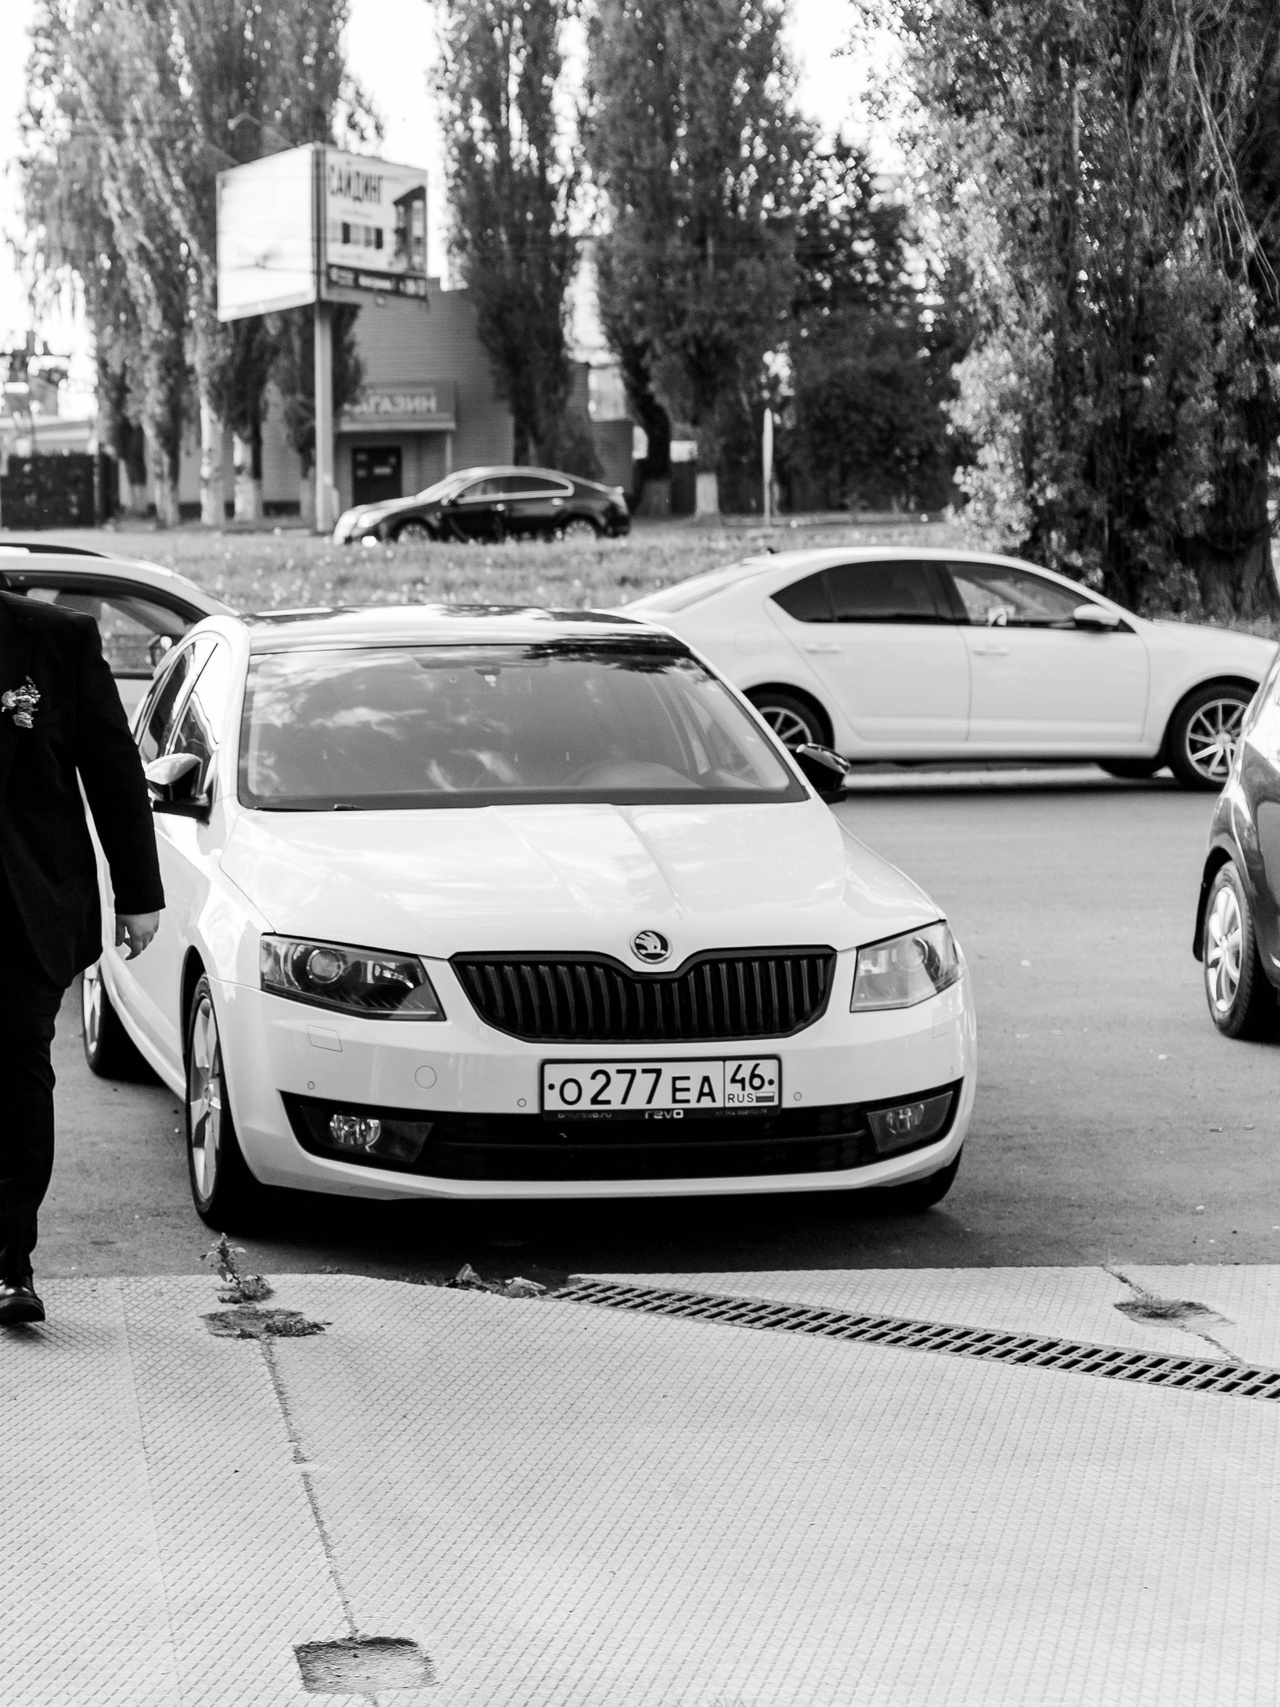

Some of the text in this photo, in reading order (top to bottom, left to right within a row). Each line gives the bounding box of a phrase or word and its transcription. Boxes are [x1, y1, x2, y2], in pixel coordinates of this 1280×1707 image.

[729, 1063, 766, 1091] 46
[727, 1092, 754, 1104] RUS
[645, 1109, 684, 1120] revo
